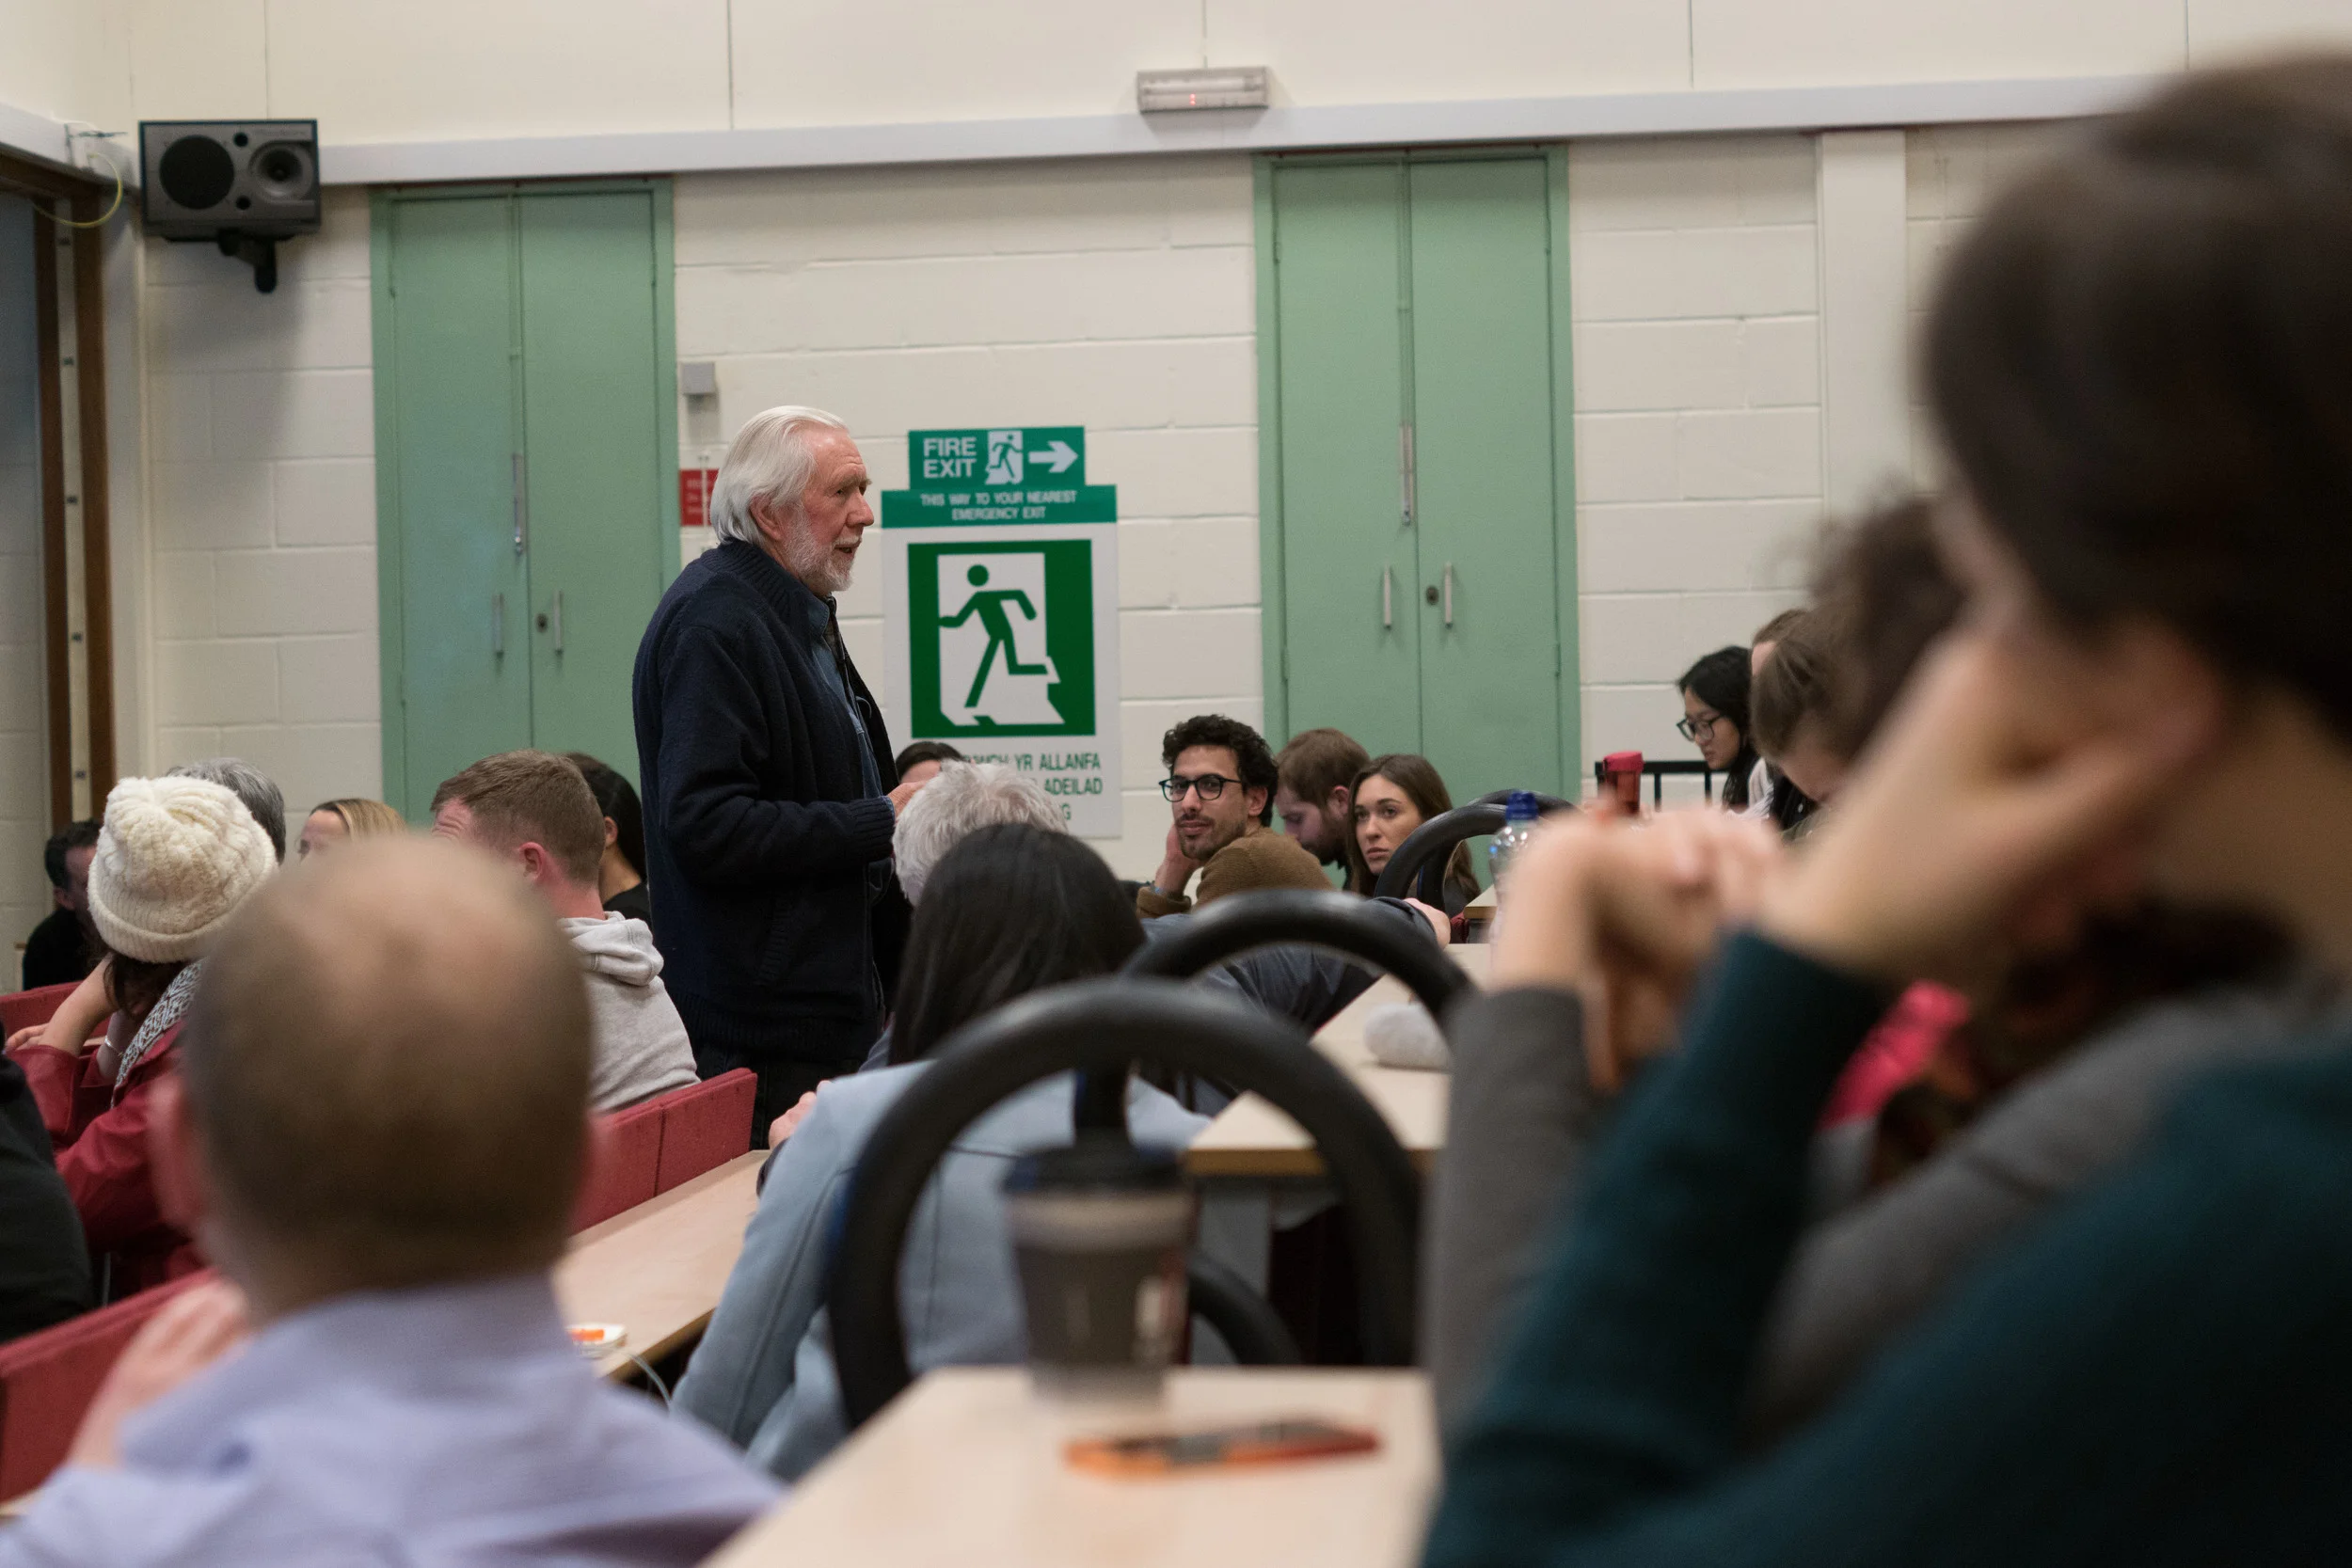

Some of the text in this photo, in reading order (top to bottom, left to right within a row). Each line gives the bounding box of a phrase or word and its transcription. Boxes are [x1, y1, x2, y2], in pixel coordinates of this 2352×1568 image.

[923, 436, 977, 457] FIRE
[923, 458, 977, 479] EXIT
[921, 490, 1077, 507] THIS WAY TO YOUR NEAREST
[952, 506, 1046, 520] EMERGENCY EXIT
[1014, 753, 1033, 771] YR
[1039, 752, 1101, 771] ALLANFA
[1044, 778, 1103, 796] ADEILAD
